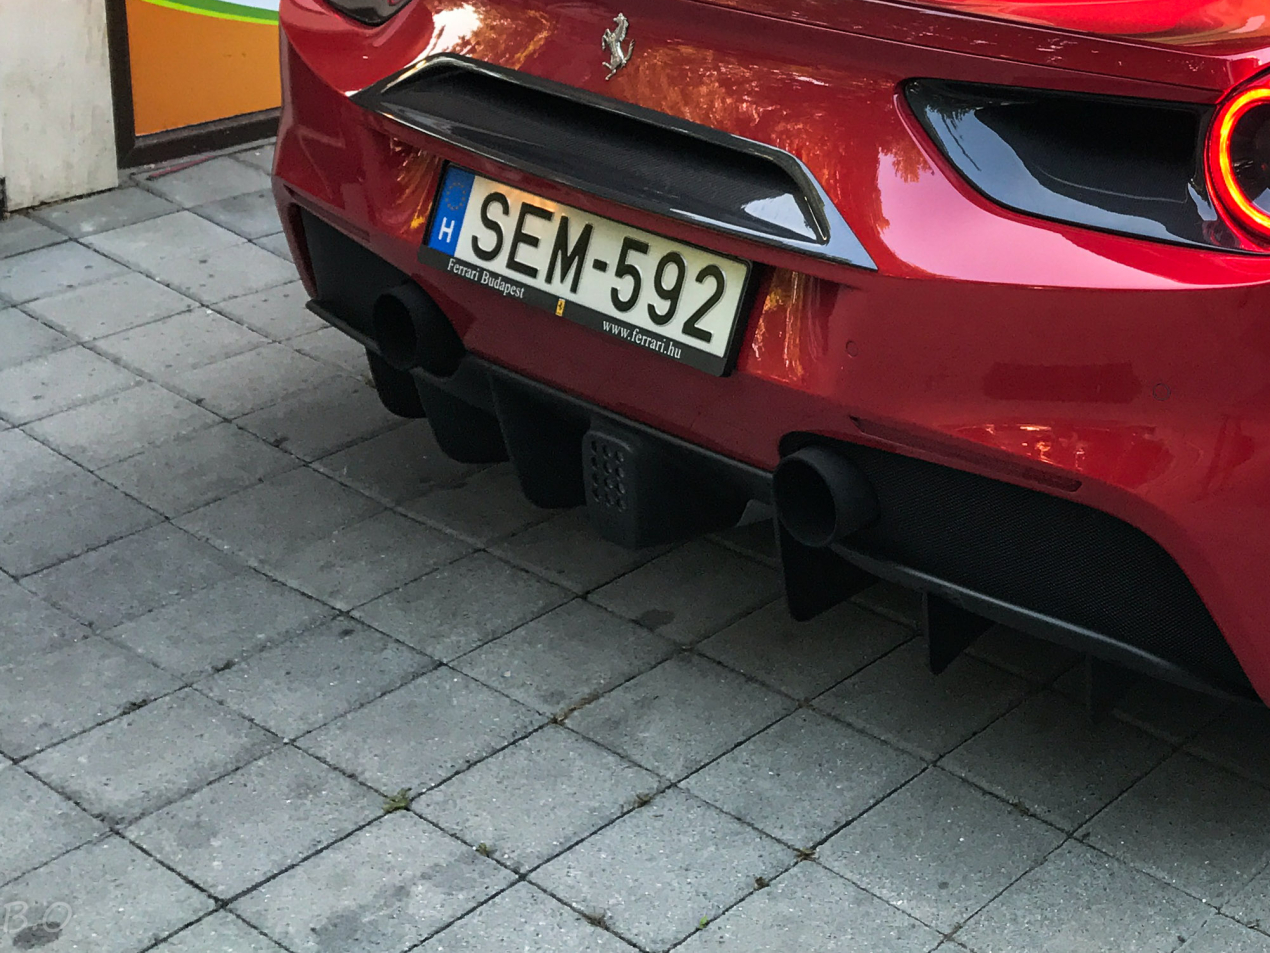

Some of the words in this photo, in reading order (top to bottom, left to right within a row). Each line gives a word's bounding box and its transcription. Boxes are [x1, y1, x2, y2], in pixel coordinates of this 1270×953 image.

[438, 216, 455, 243] H
[471, 191, 726, 344] SEM-592
[447, 258, 480, 282] Ferrari
[480, 270, 525, 299] Budapest
[602, 319, 682, 360] www.ferrari.hu
